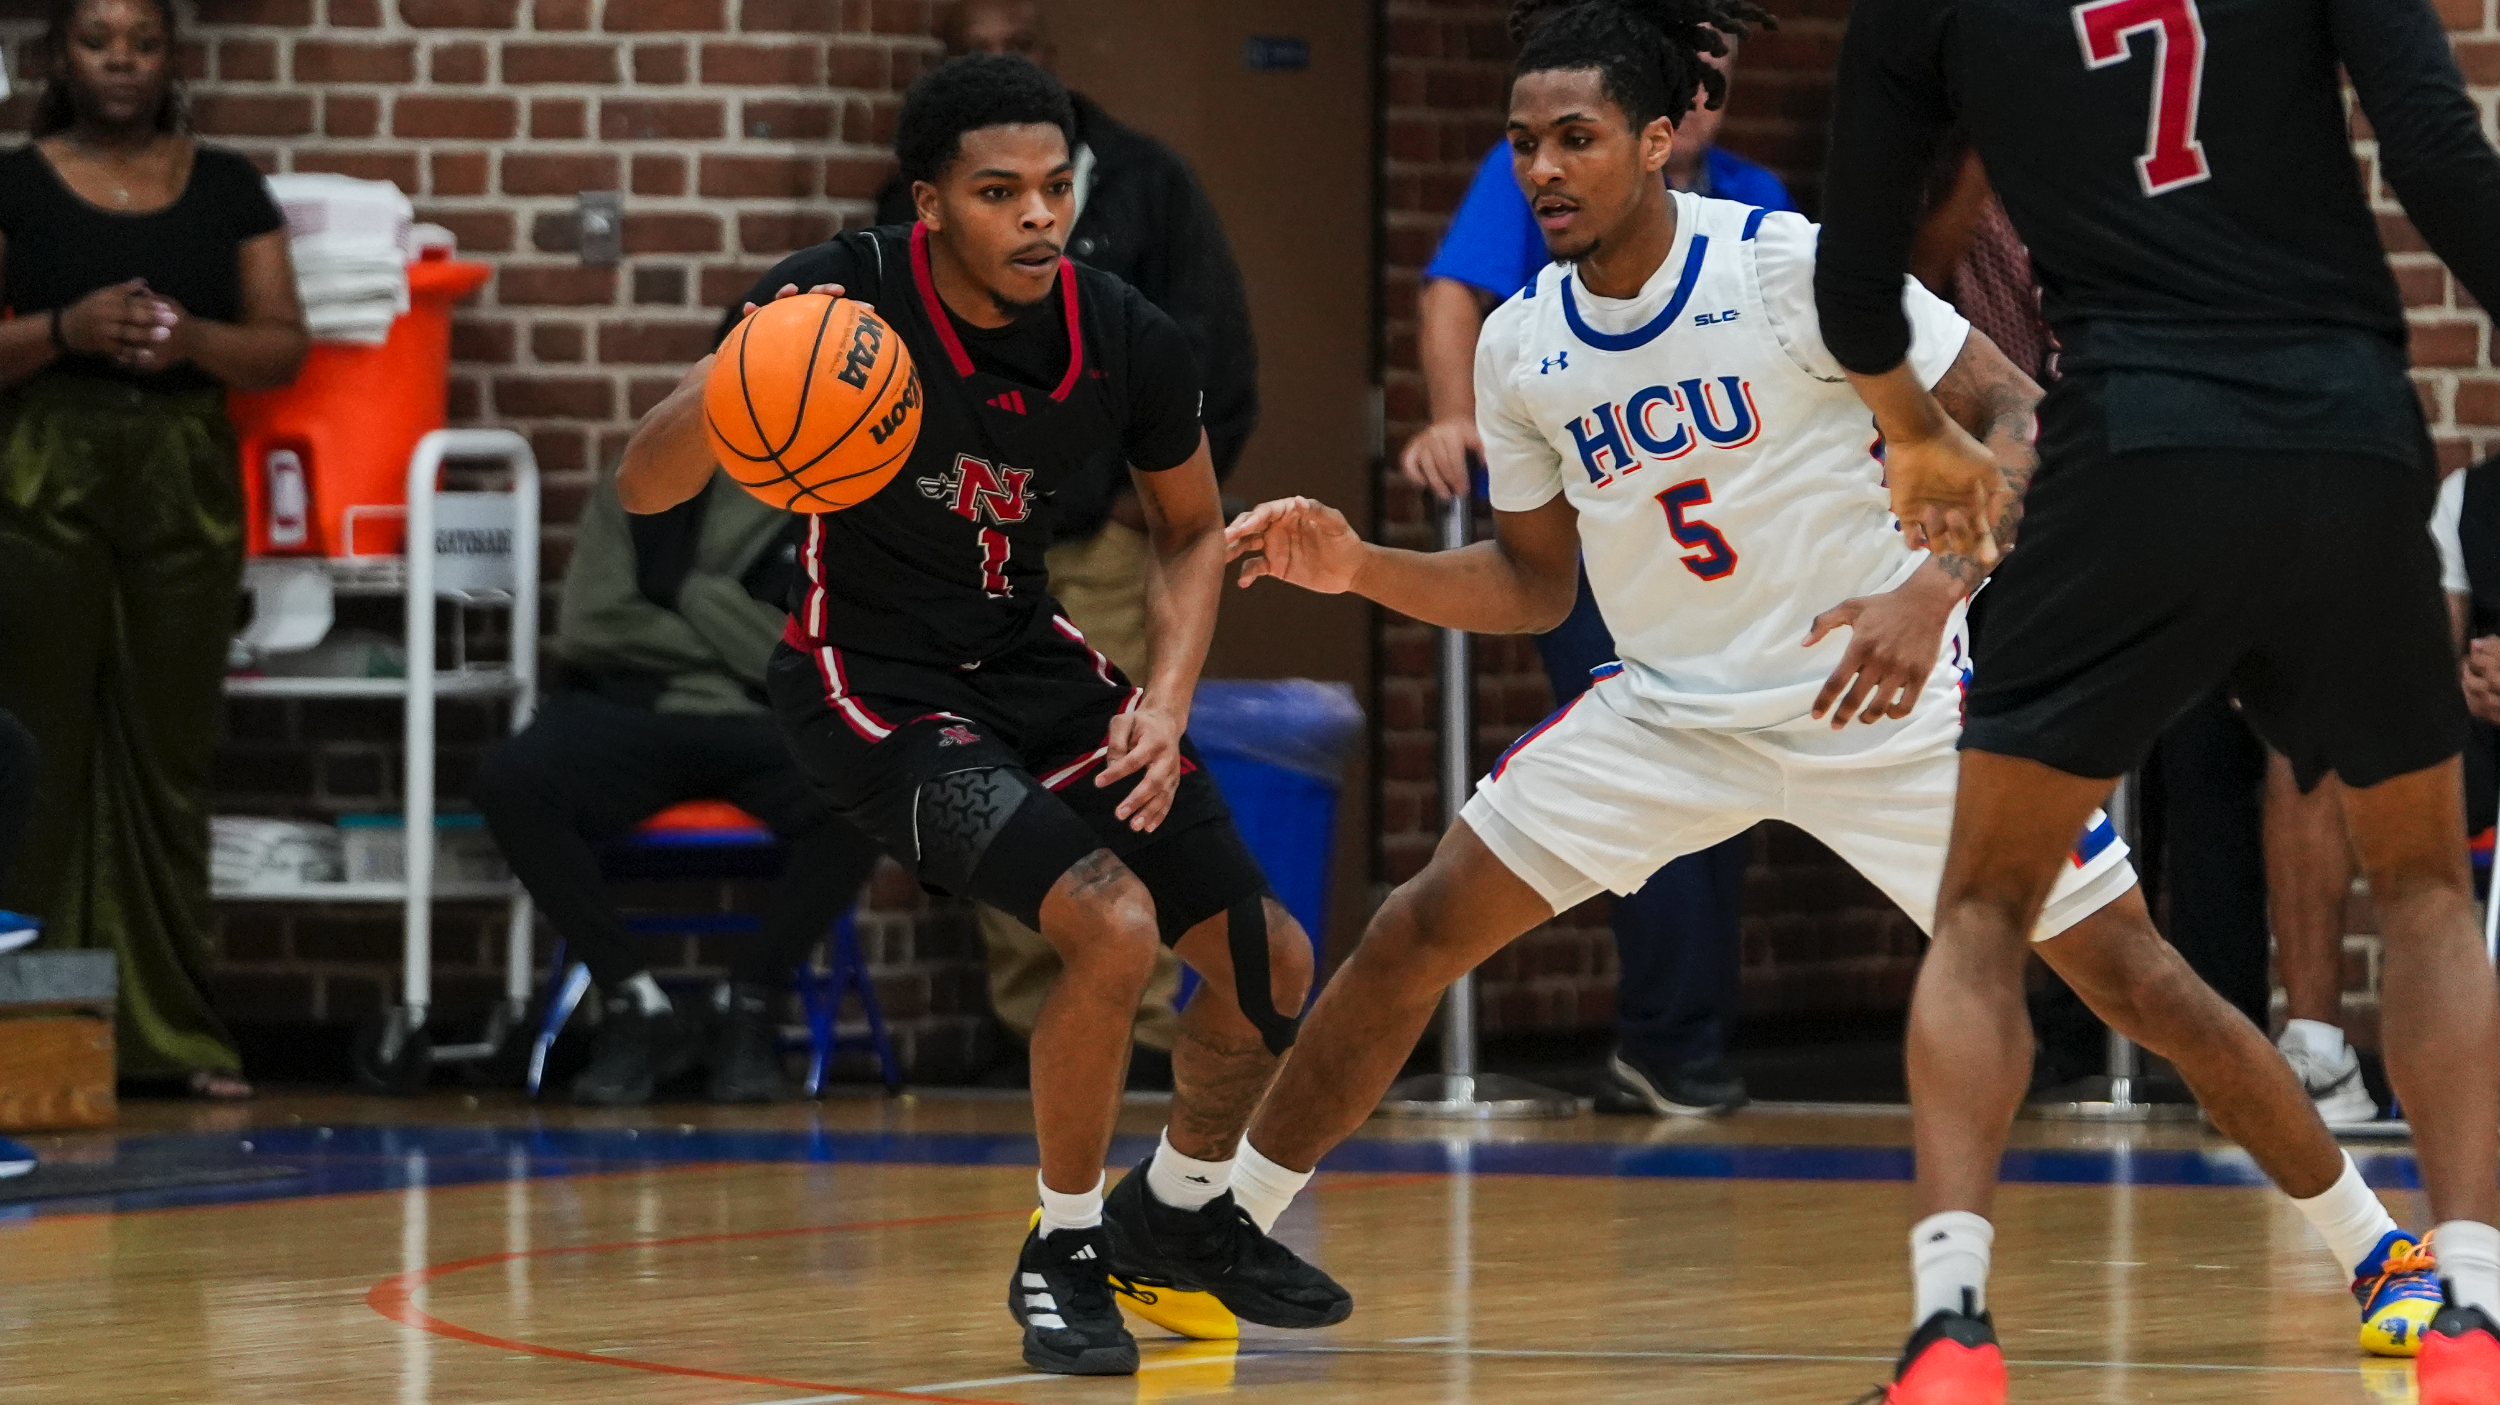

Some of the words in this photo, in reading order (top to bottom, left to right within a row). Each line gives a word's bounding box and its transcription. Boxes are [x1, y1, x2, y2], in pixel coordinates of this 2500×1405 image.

[2071, 0, 2211, 196] 7
[837, 309, 884, 390] NCAA
[1565, 376, 1761, 489] HCU
[947, 452, 1033, 524] N
[1654, 477, 1738, 582] 5
[977, 526, 1013, 599] 1
